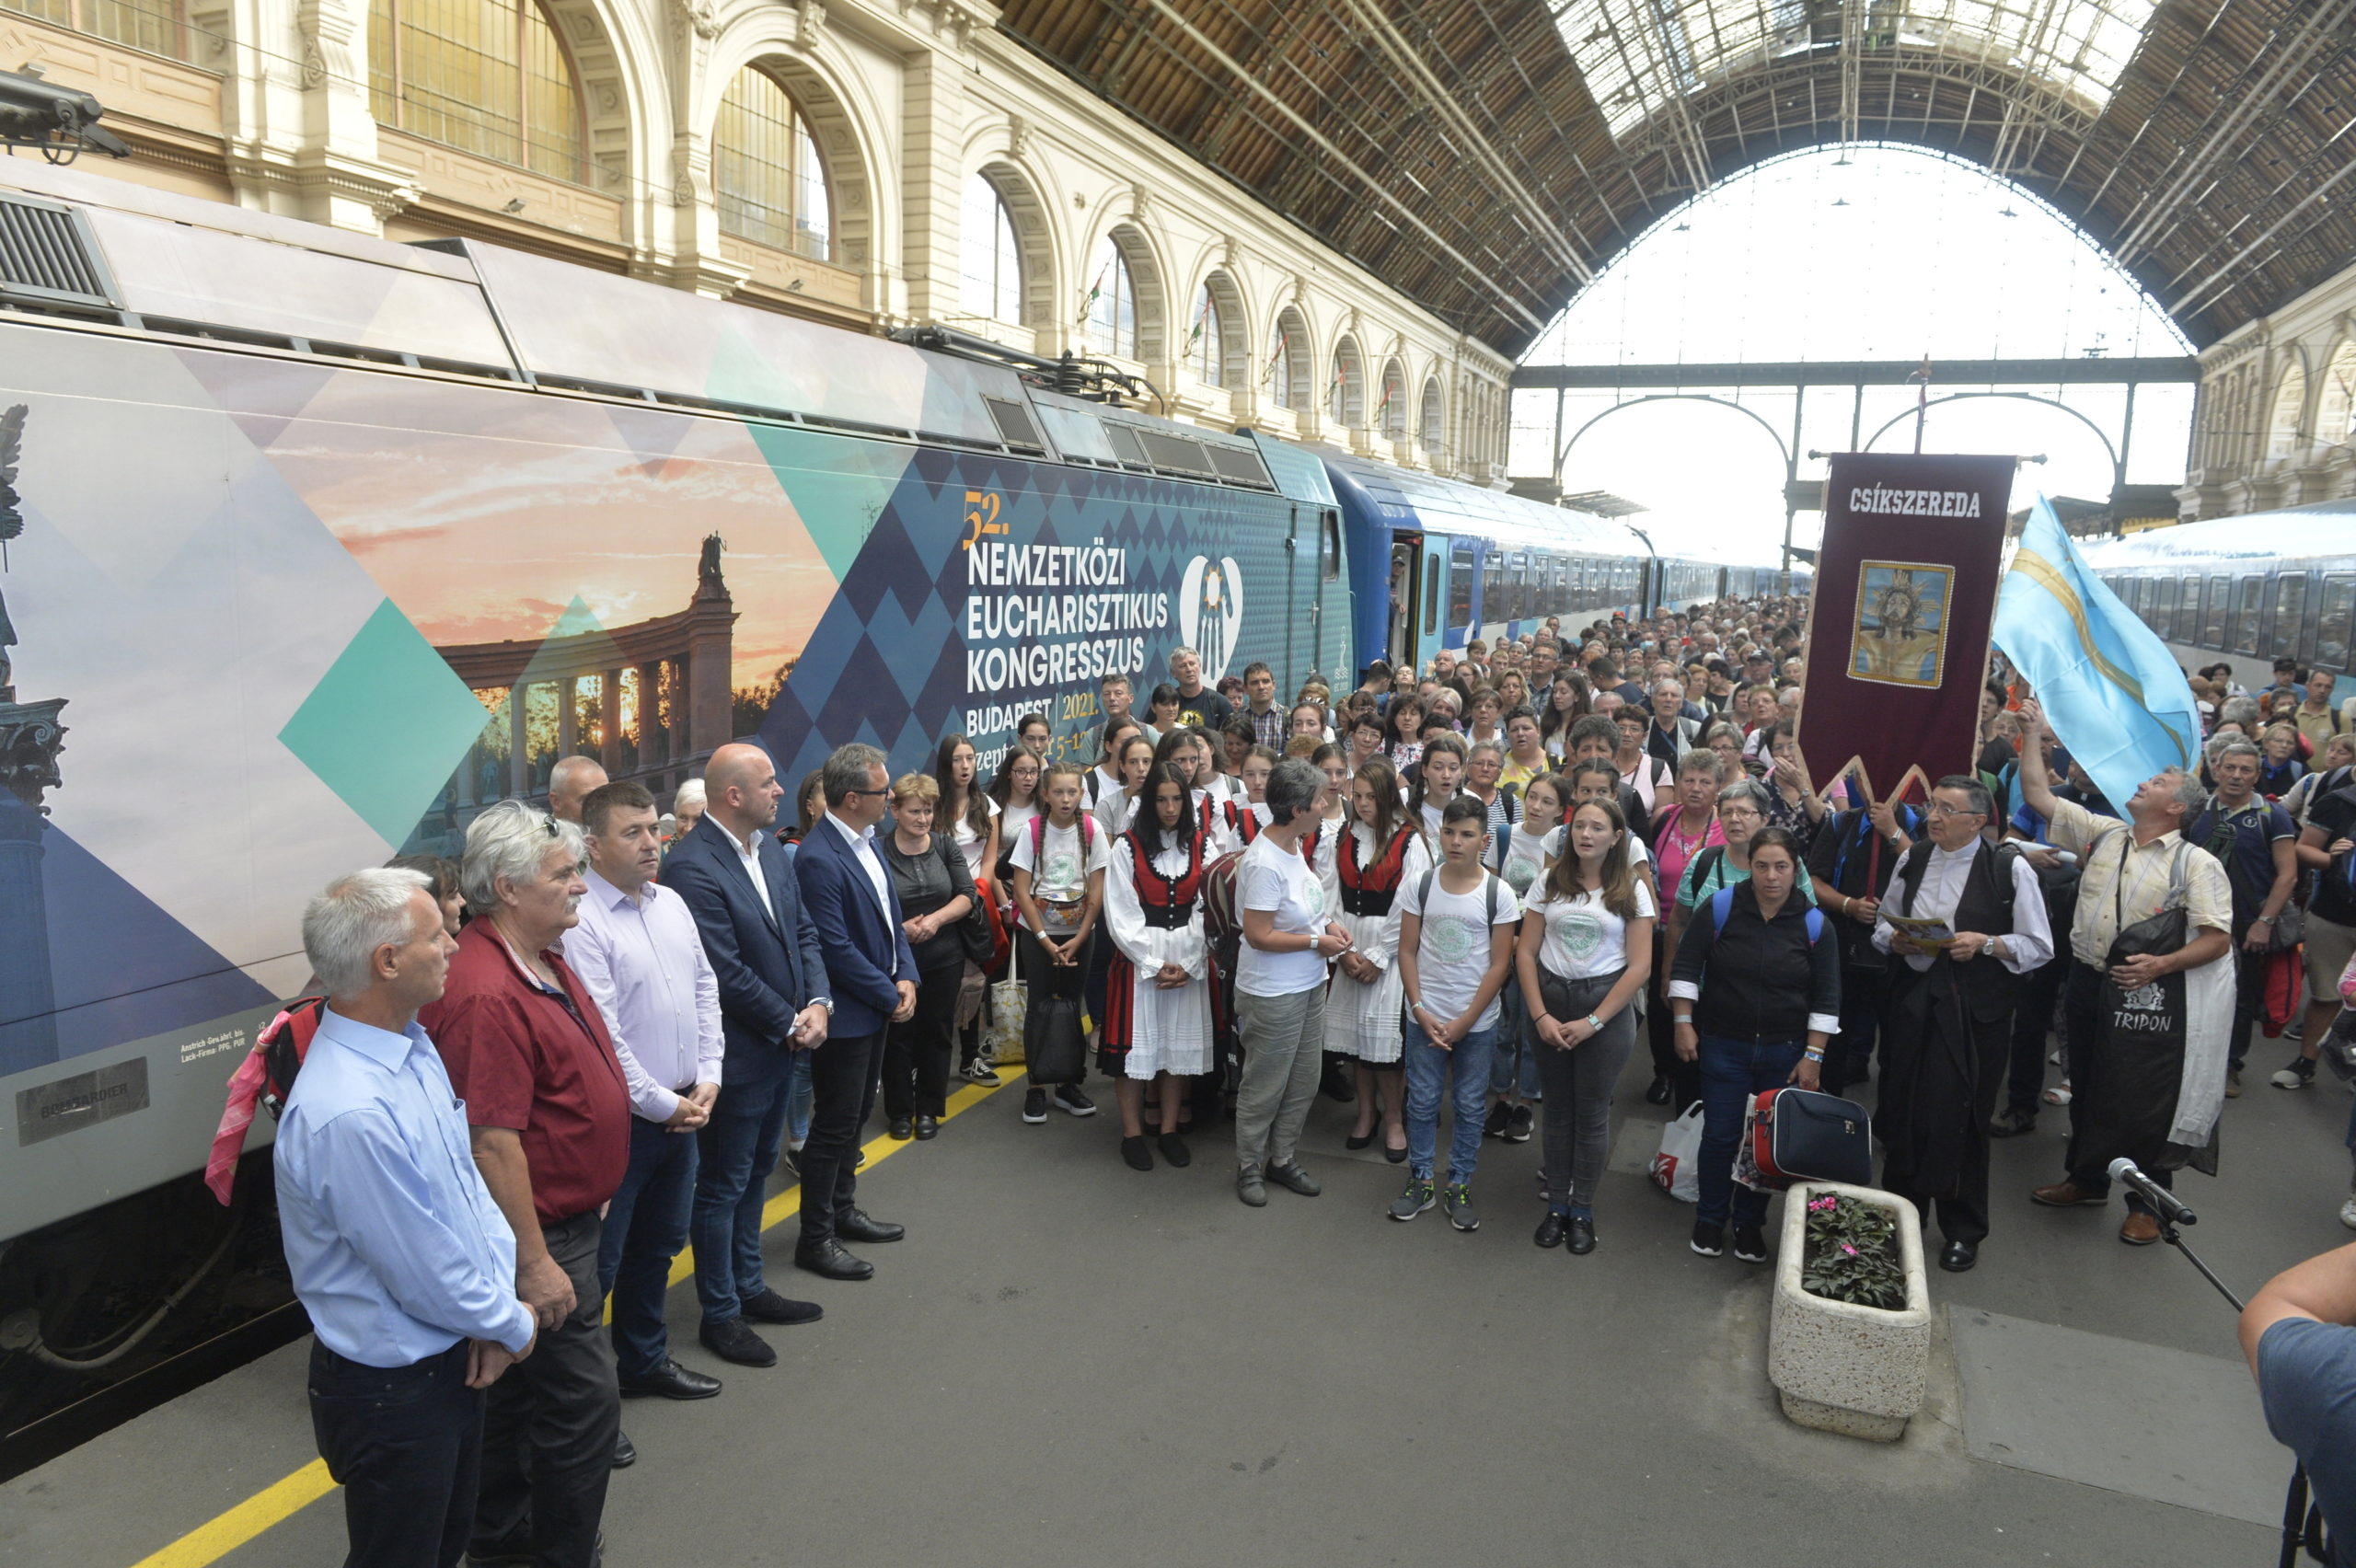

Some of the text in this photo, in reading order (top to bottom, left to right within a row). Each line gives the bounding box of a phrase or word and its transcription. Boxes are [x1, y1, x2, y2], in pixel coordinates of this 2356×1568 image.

[963, 491, 1009, 550] 52.
[1850, 481, 1981, 517] CSÍKSZEREDA
[968, 537, 1125, 586] NEMZETKÖZI
[967, 593, 1168, 640] EUCHARISZTIKUS
[966, 636, 1144, 693] KONGRESSZUS
[1063, 692, 1099, 721] 2021.
[2114, 1011, 2172, 1032] TRIPON
